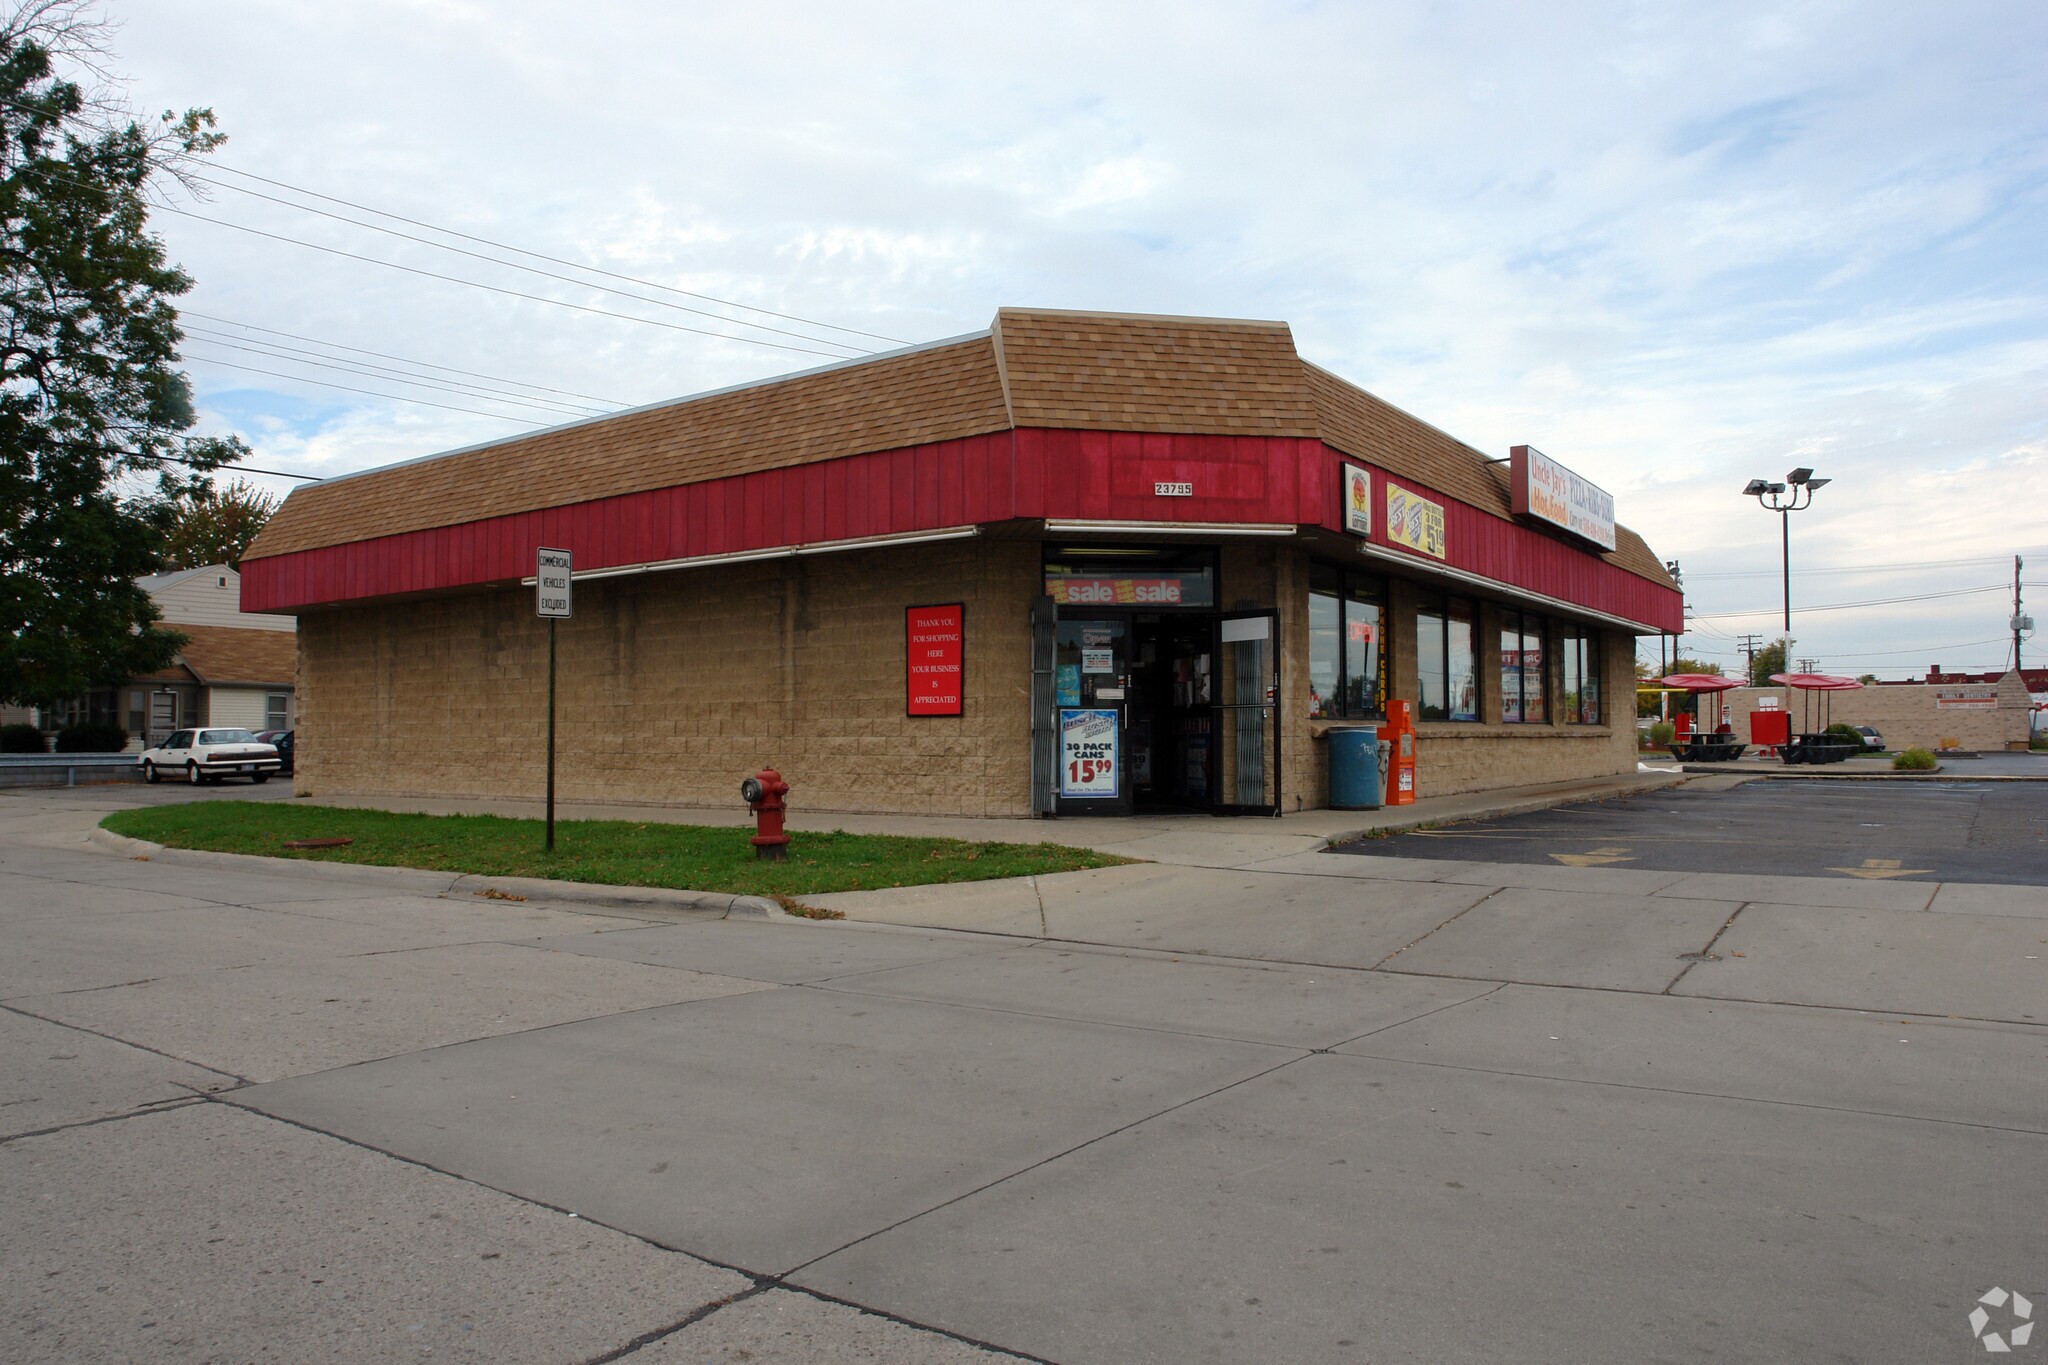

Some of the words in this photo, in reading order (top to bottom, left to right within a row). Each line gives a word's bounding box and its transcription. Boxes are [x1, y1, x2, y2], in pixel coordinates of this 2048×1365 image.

[1531, 455, 1549, 486] Uncle
[1551, 466, 1566, 496] Jay's
[1156, 484, 1191, 494] 23795
[540, 556, 570, 568] COMMERCIAL
[543, 577, 565, 588] VEHICLES
[1068, 581, 1113, 601] sale
[1134, 581, 1180, 601] sale
[542, 598, 567, 609] EXCLUDED
[926, 634, 958, 642] SHOPPING
[1349, 622, 1376, 643] OPEN
[1083, 632, 1111, 646] Open
[931, 665, 959, 673] BUSINESS
[914, 696, 956, 704] APPRECIATED
[1063, 713, 1096, 728] BUSCH
